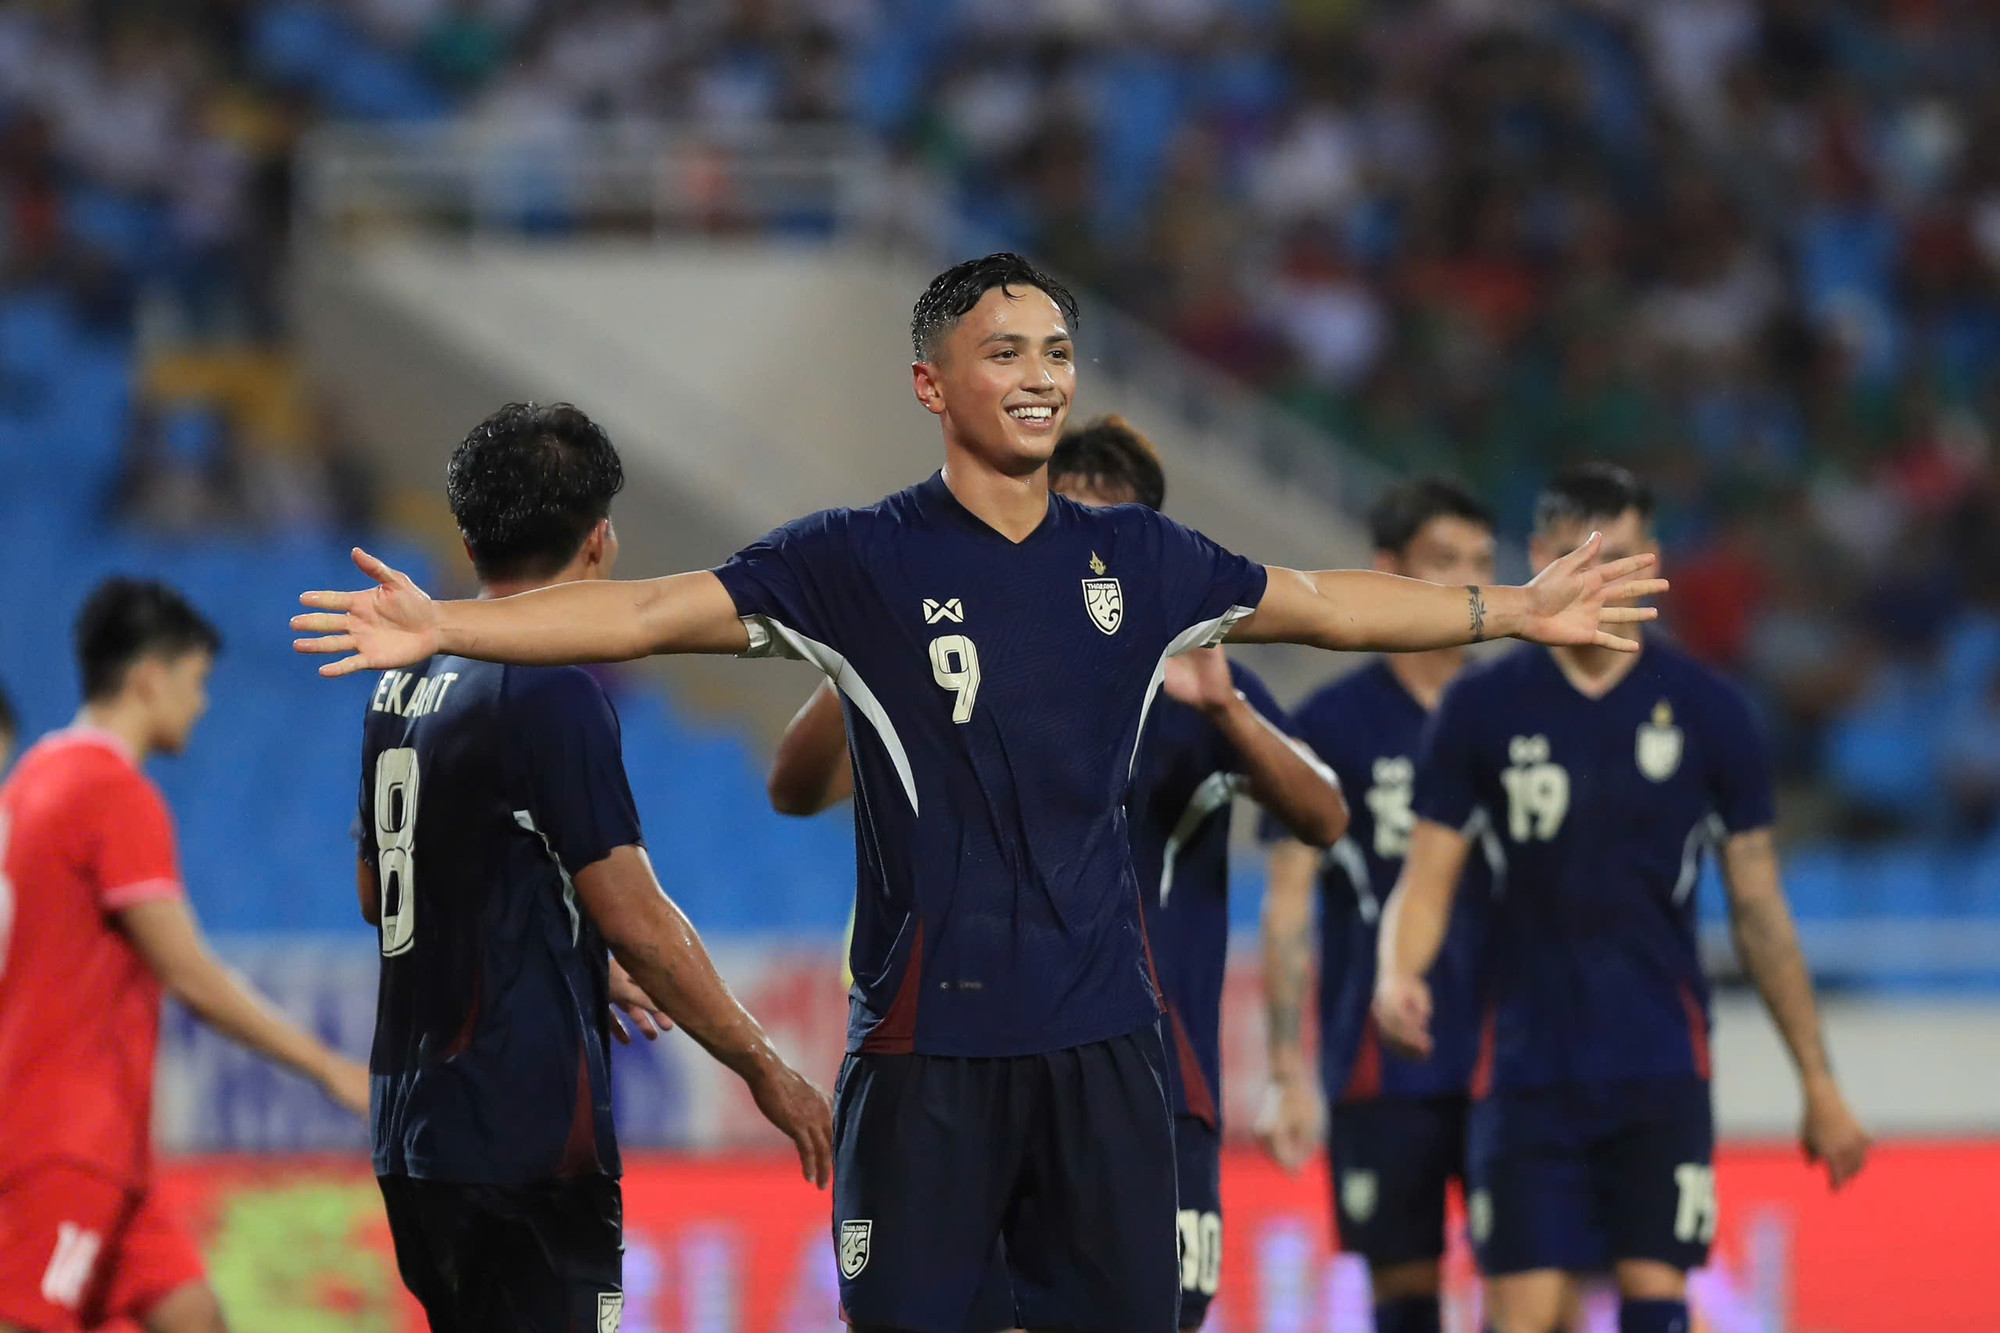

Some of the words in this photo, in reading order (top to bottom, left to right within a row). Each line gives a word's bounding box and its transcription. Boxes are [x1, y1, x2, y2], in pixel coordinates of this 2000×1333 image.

[928, 634, 980, 724] 9
[1501, 763, 1570, 842] 19
[374, 747, 420, 957] 8
